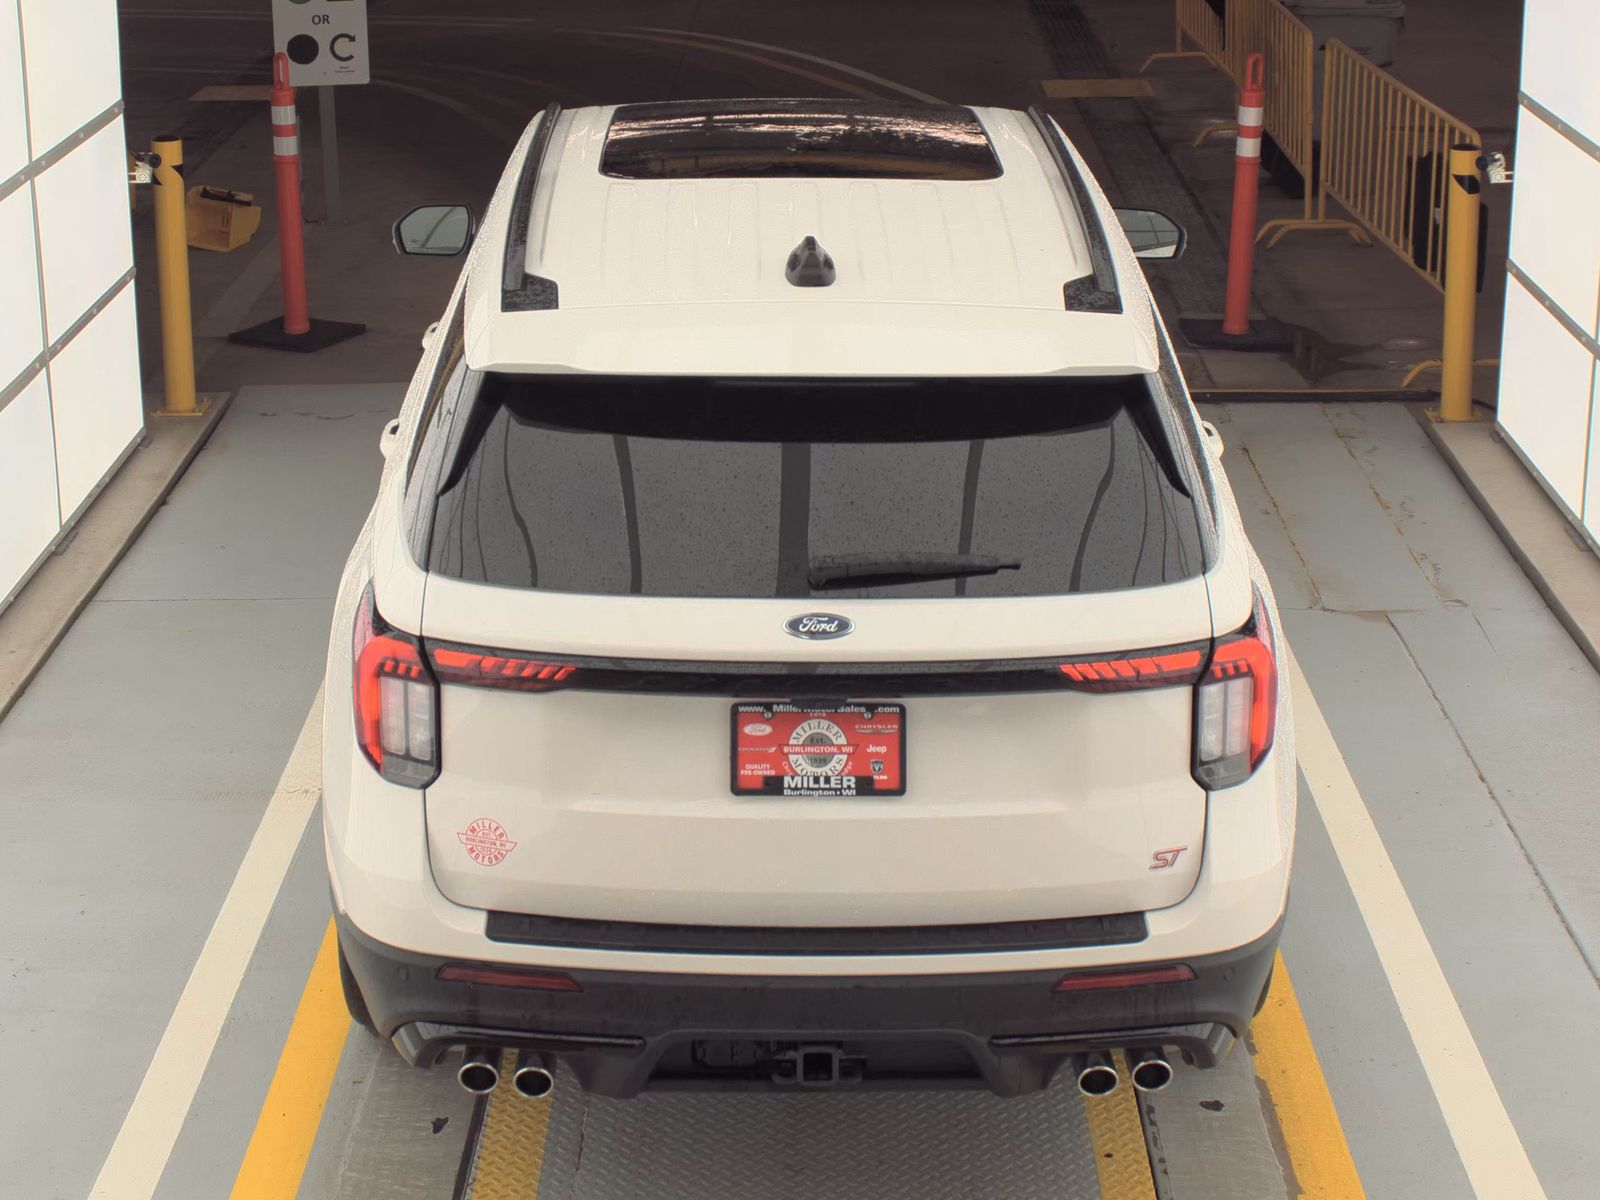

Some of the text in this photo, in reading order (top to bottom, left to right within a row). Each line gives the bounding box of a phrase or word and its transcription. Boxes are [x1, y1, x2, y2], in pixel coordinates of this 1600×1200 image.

[311, 14, 330, 25] OR
[798, 616, 839, 632] Ford
[792, 720, 842, 743] MILLER
[841, 745, 853, 754] WI
[866, 744, 887, 755] Jeep
[783, 776, 856, 789] MILLER
[783, 789, 836, 797] Burlington
[469, 820, 505, 840] MILLER
[468, 846, 504, 864] MOTORS
[1149, 847, 1188, 870] ST
